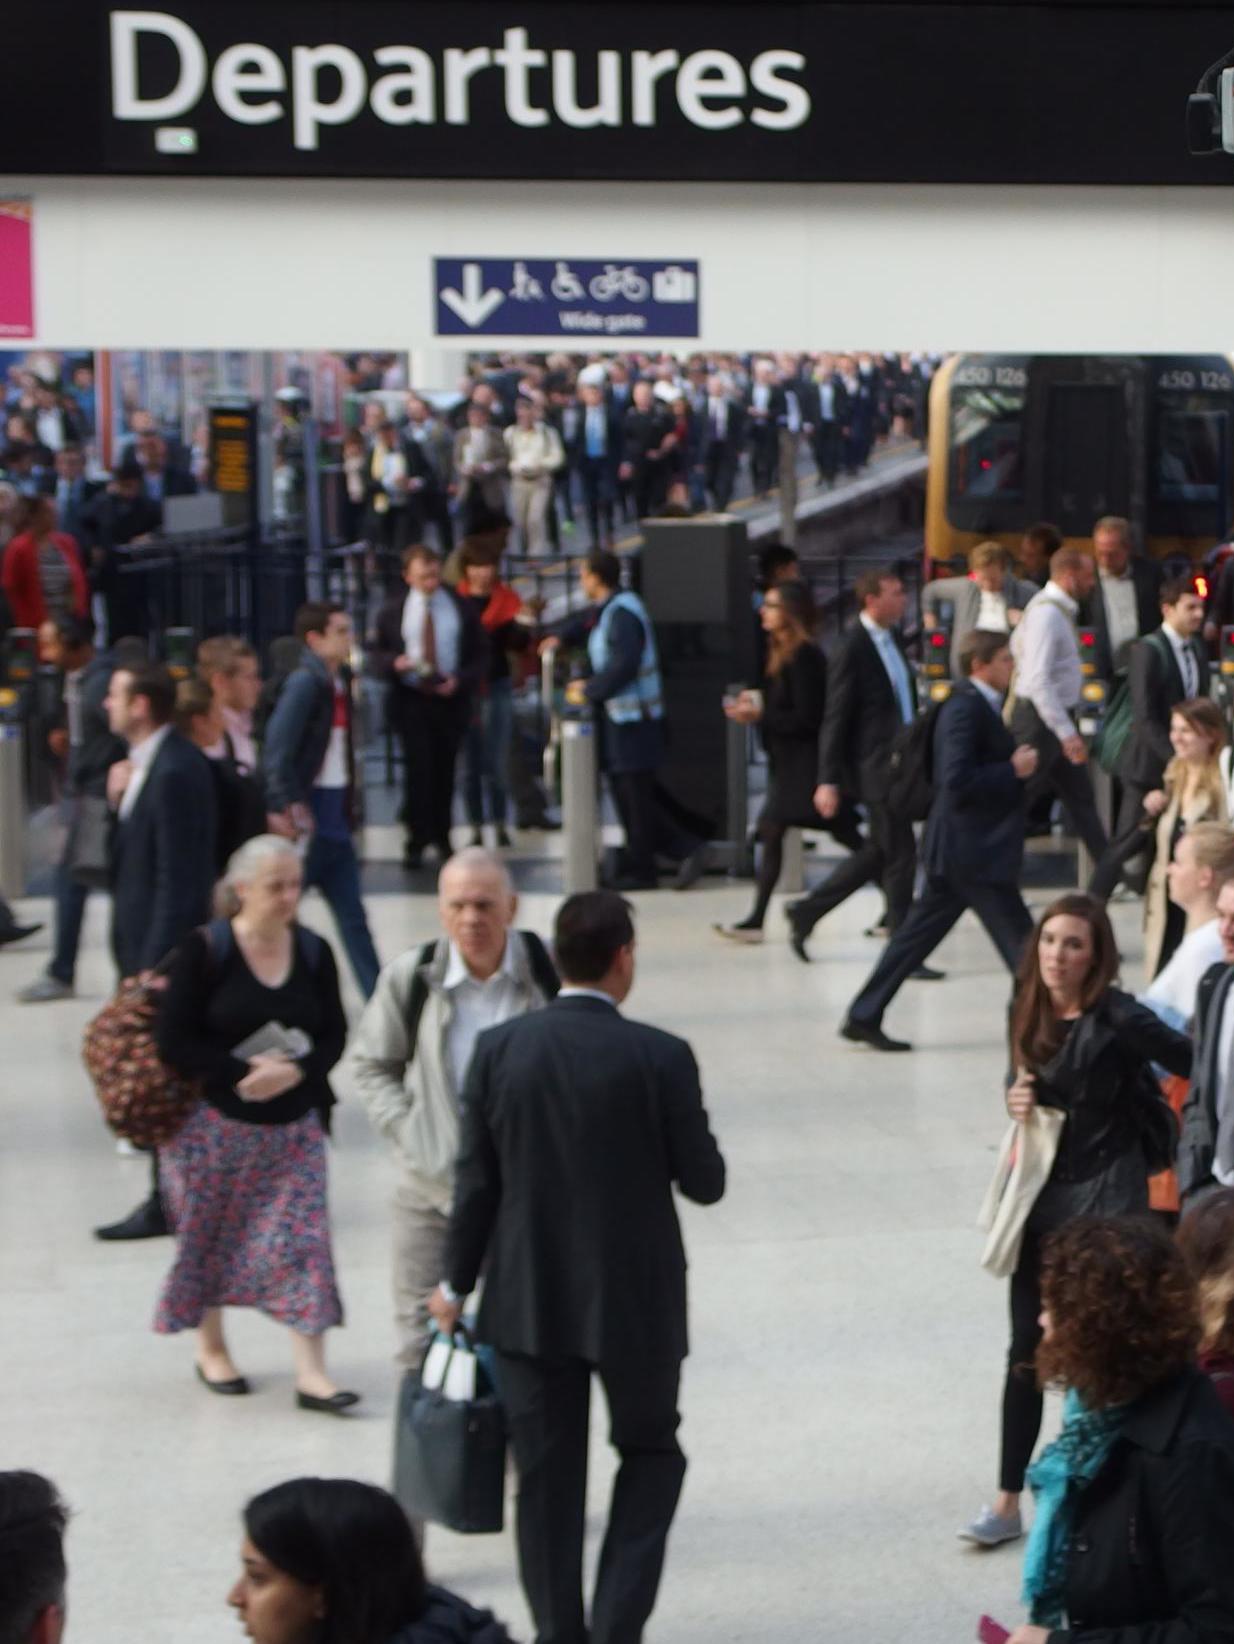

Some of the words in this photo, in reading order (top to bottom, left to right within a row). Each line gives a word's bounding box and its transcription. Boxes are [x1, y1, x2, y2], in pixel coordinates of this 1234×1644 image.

[109, 9, 811, 150] Departures
[558, 310, 603, 330] Wide
[604, 314, 648, 335] gate
[995, 368, 1026, 387] 126
[1199, 371, 1233, 389] 126
